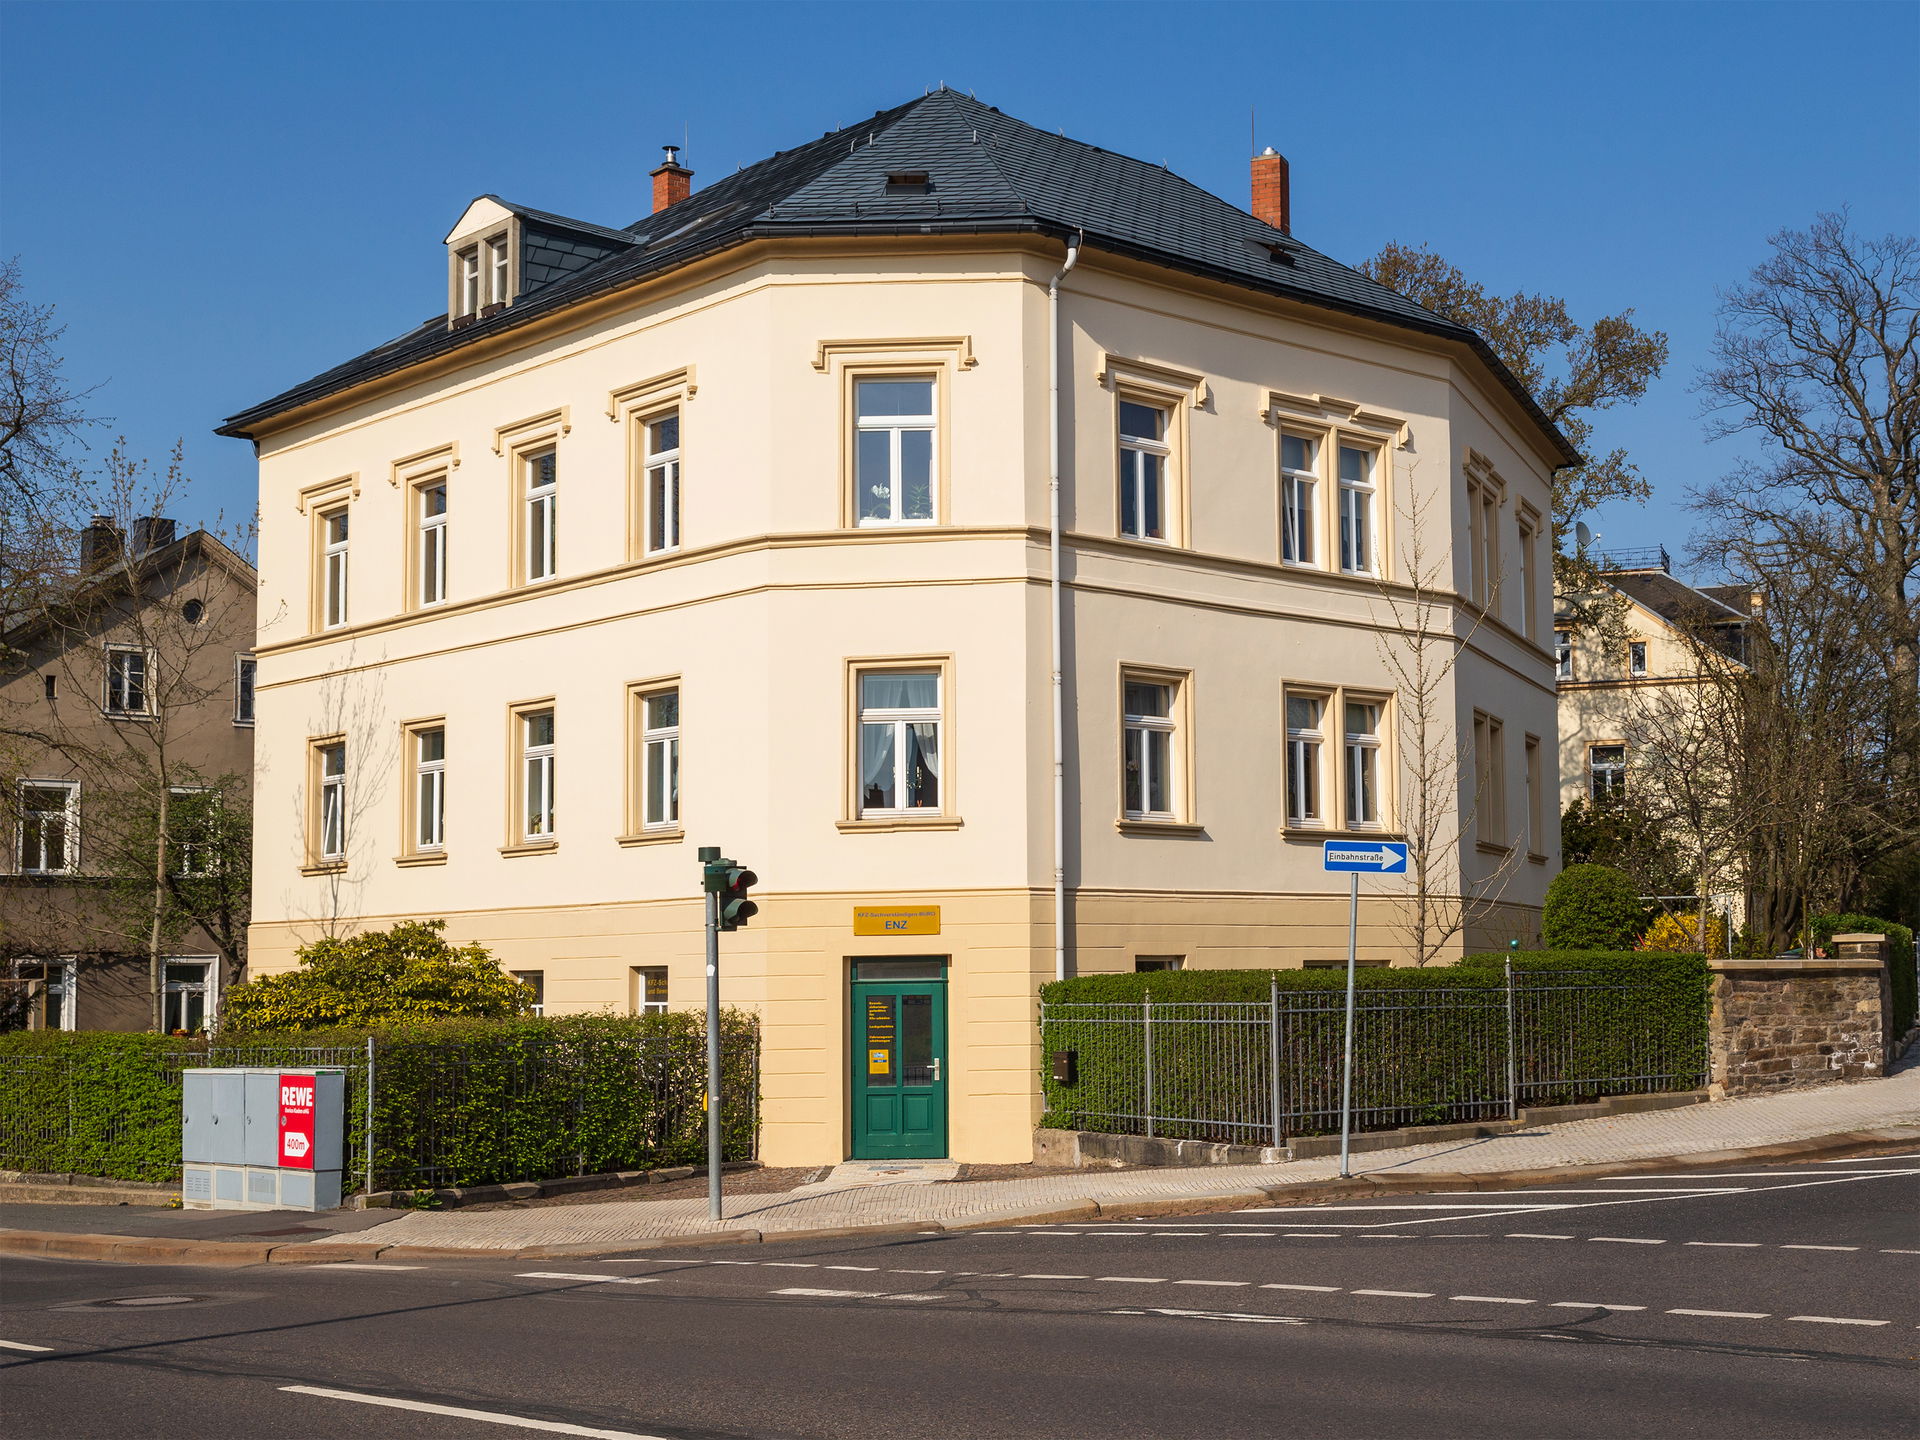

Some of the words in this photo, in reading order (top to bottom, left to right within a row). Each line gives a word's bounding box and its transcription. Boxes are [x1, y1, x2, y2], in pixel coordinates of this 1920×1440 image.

[1329, 852, 1384, 862] Einbahnstraße
[885, 920, 908, 930] ENZ
[281, 1087, 313, 1107] REWE
[287, 1138, 306, 1150] 400m
